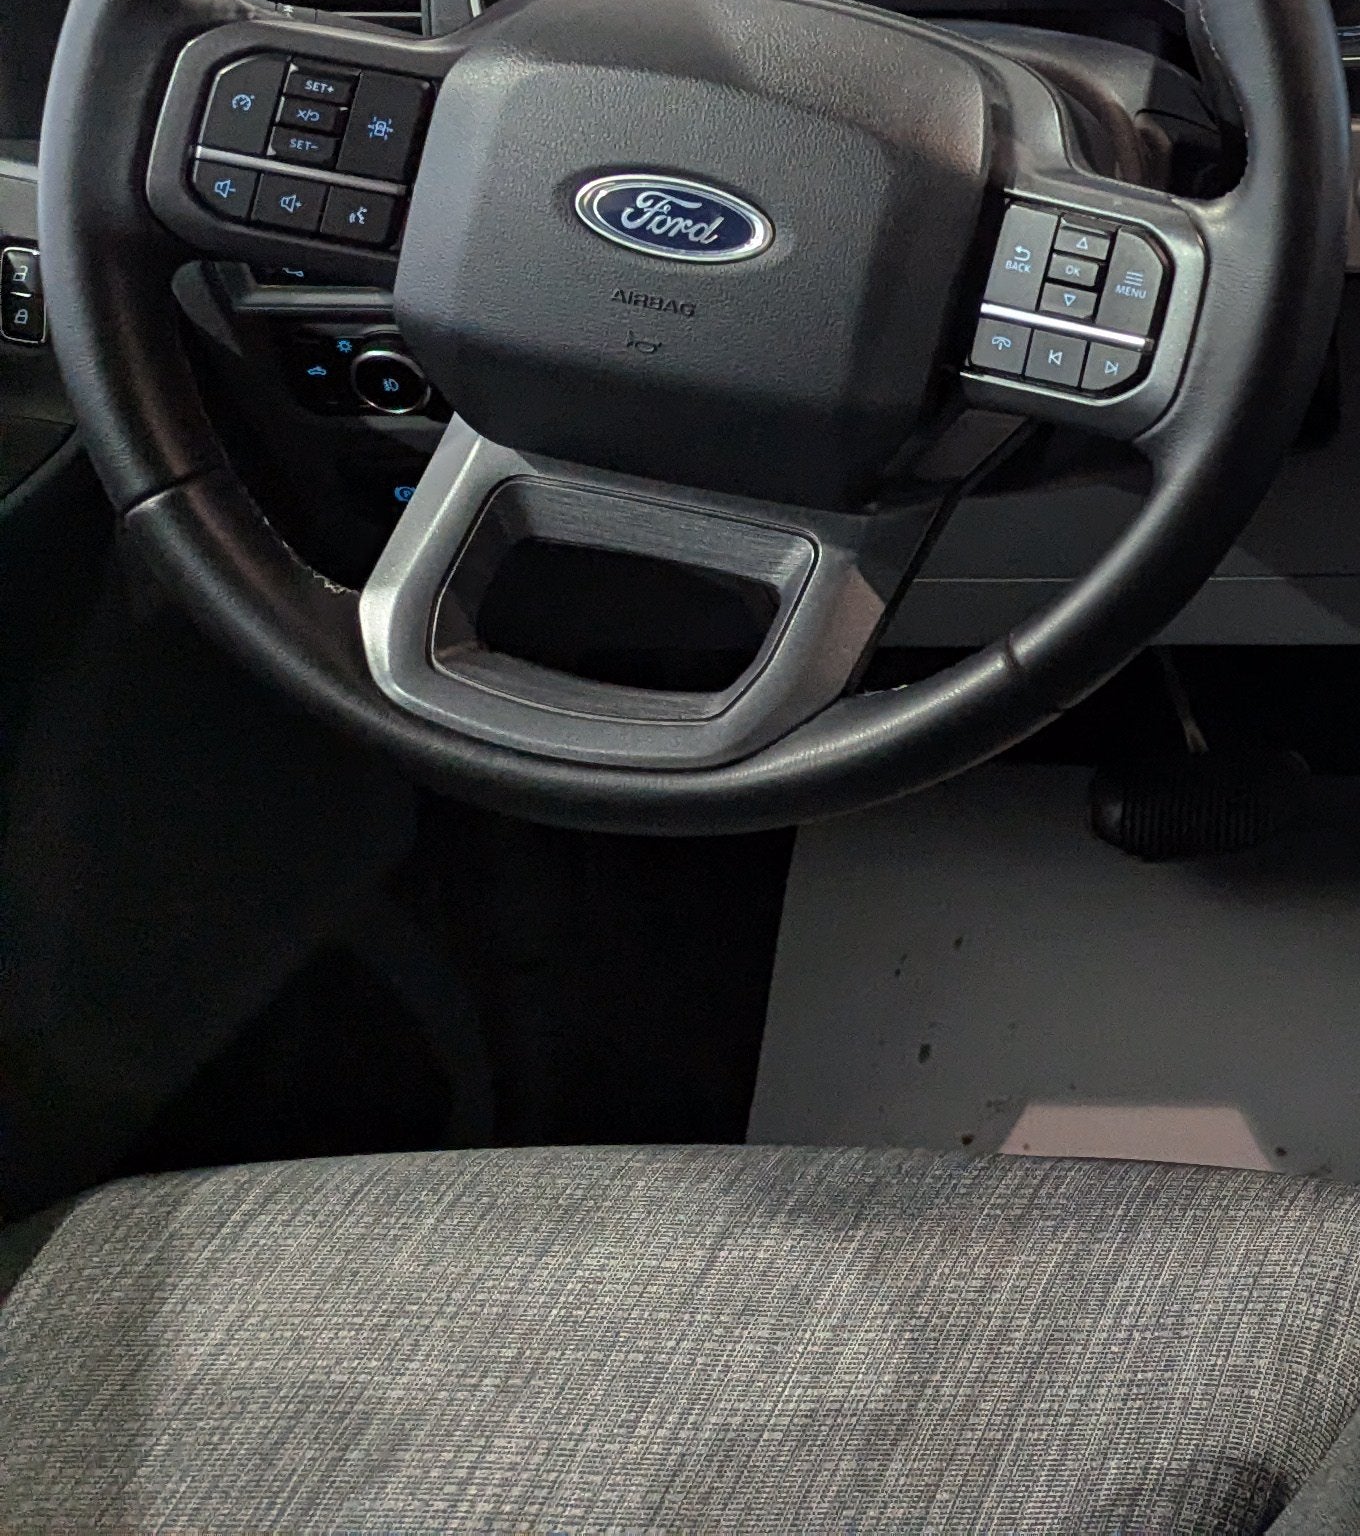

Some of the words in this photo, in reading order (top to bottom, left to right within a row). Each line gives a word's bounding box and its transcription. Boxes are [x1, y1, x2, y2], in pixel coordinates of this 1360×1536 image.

[621, 191, 724, 244] Ford
[1005, 260, 1031, 273] BACK
[1065, 265, 1081, 277] OK
[1115, 285, 1146, 299] MENU
[611, 288, 697, 317] AIRBAG
